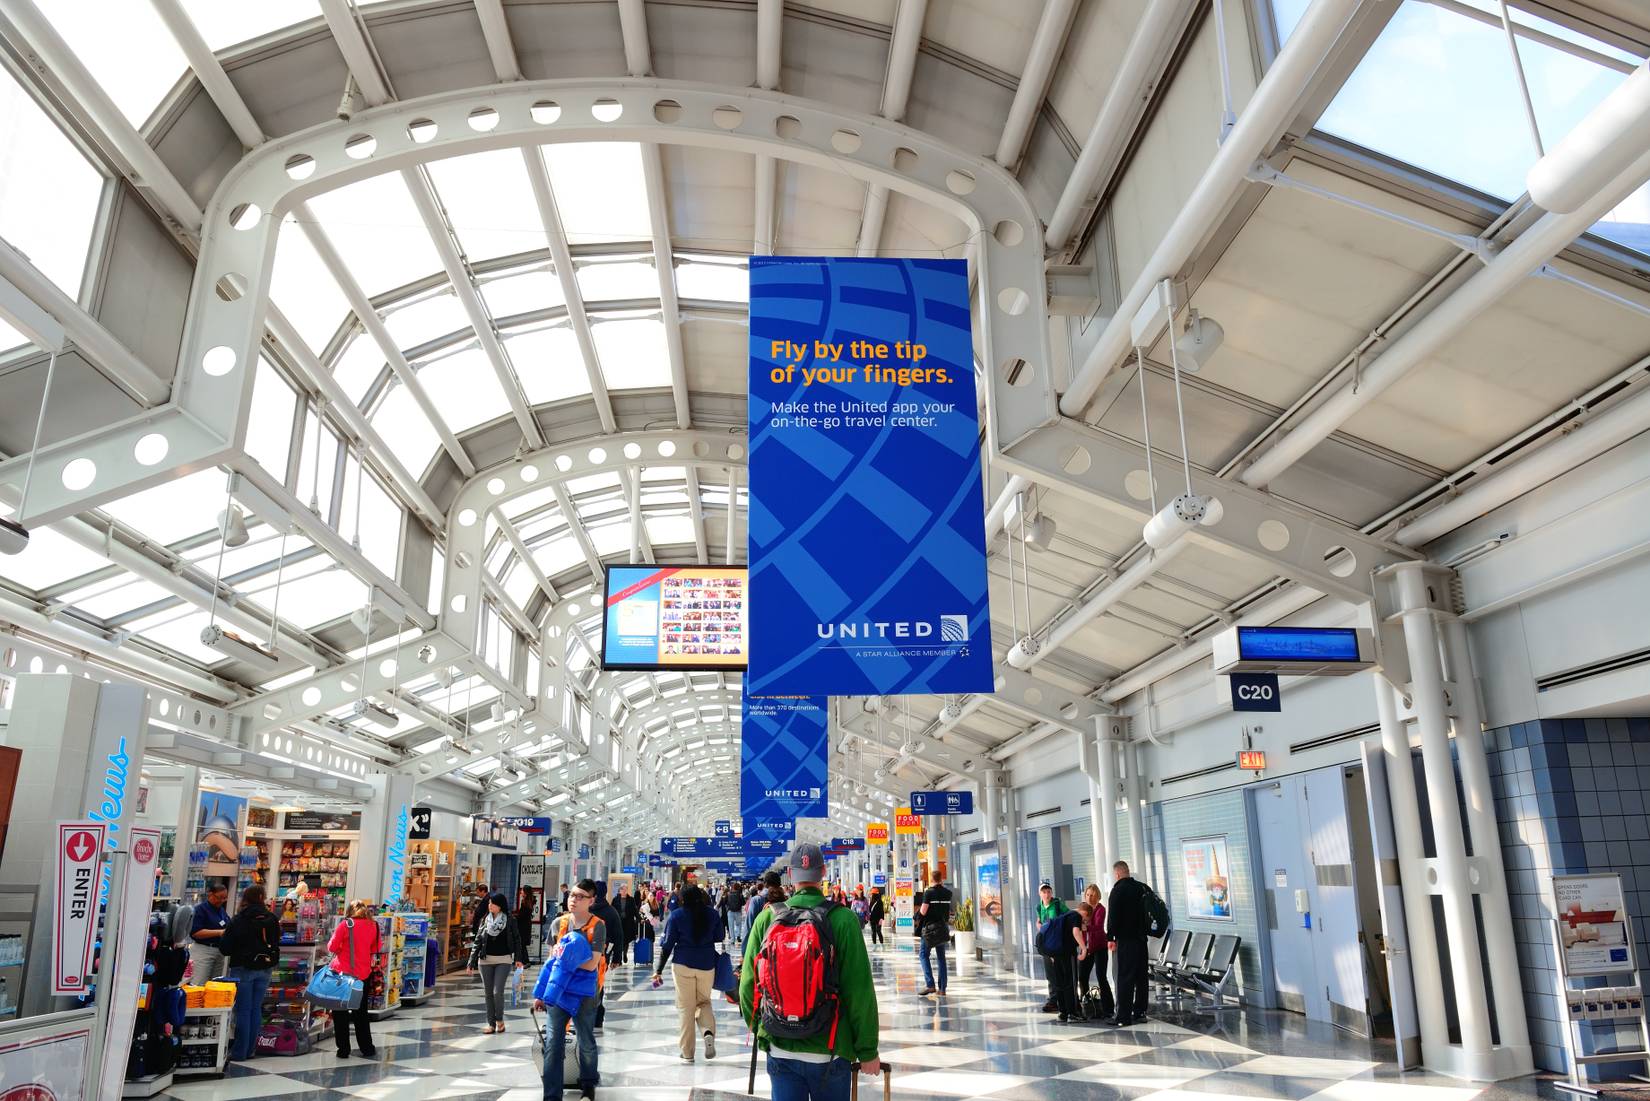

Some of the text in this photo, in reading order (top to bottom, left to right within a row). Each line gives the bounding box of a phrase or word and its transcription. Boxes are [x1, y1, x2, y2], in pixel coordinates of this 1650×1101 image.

[771, 340, 928, 362] Fly by the tip
[770, 365, 954, 386] of your fingers.
[771, 401, 956, 415] Make the United app your
[771, 415, 938, 429] on-the-go travel center.
[817, 622, 933, 639] UNITED
[1238, 685, 1273, 700] C20
[1242, 751, 1264, 765] EXIT
[842, 838, 855, 846] C18
[522, 864, 543, 875] CHOCOLATE
[70, 868, 91, 920] ENTER
